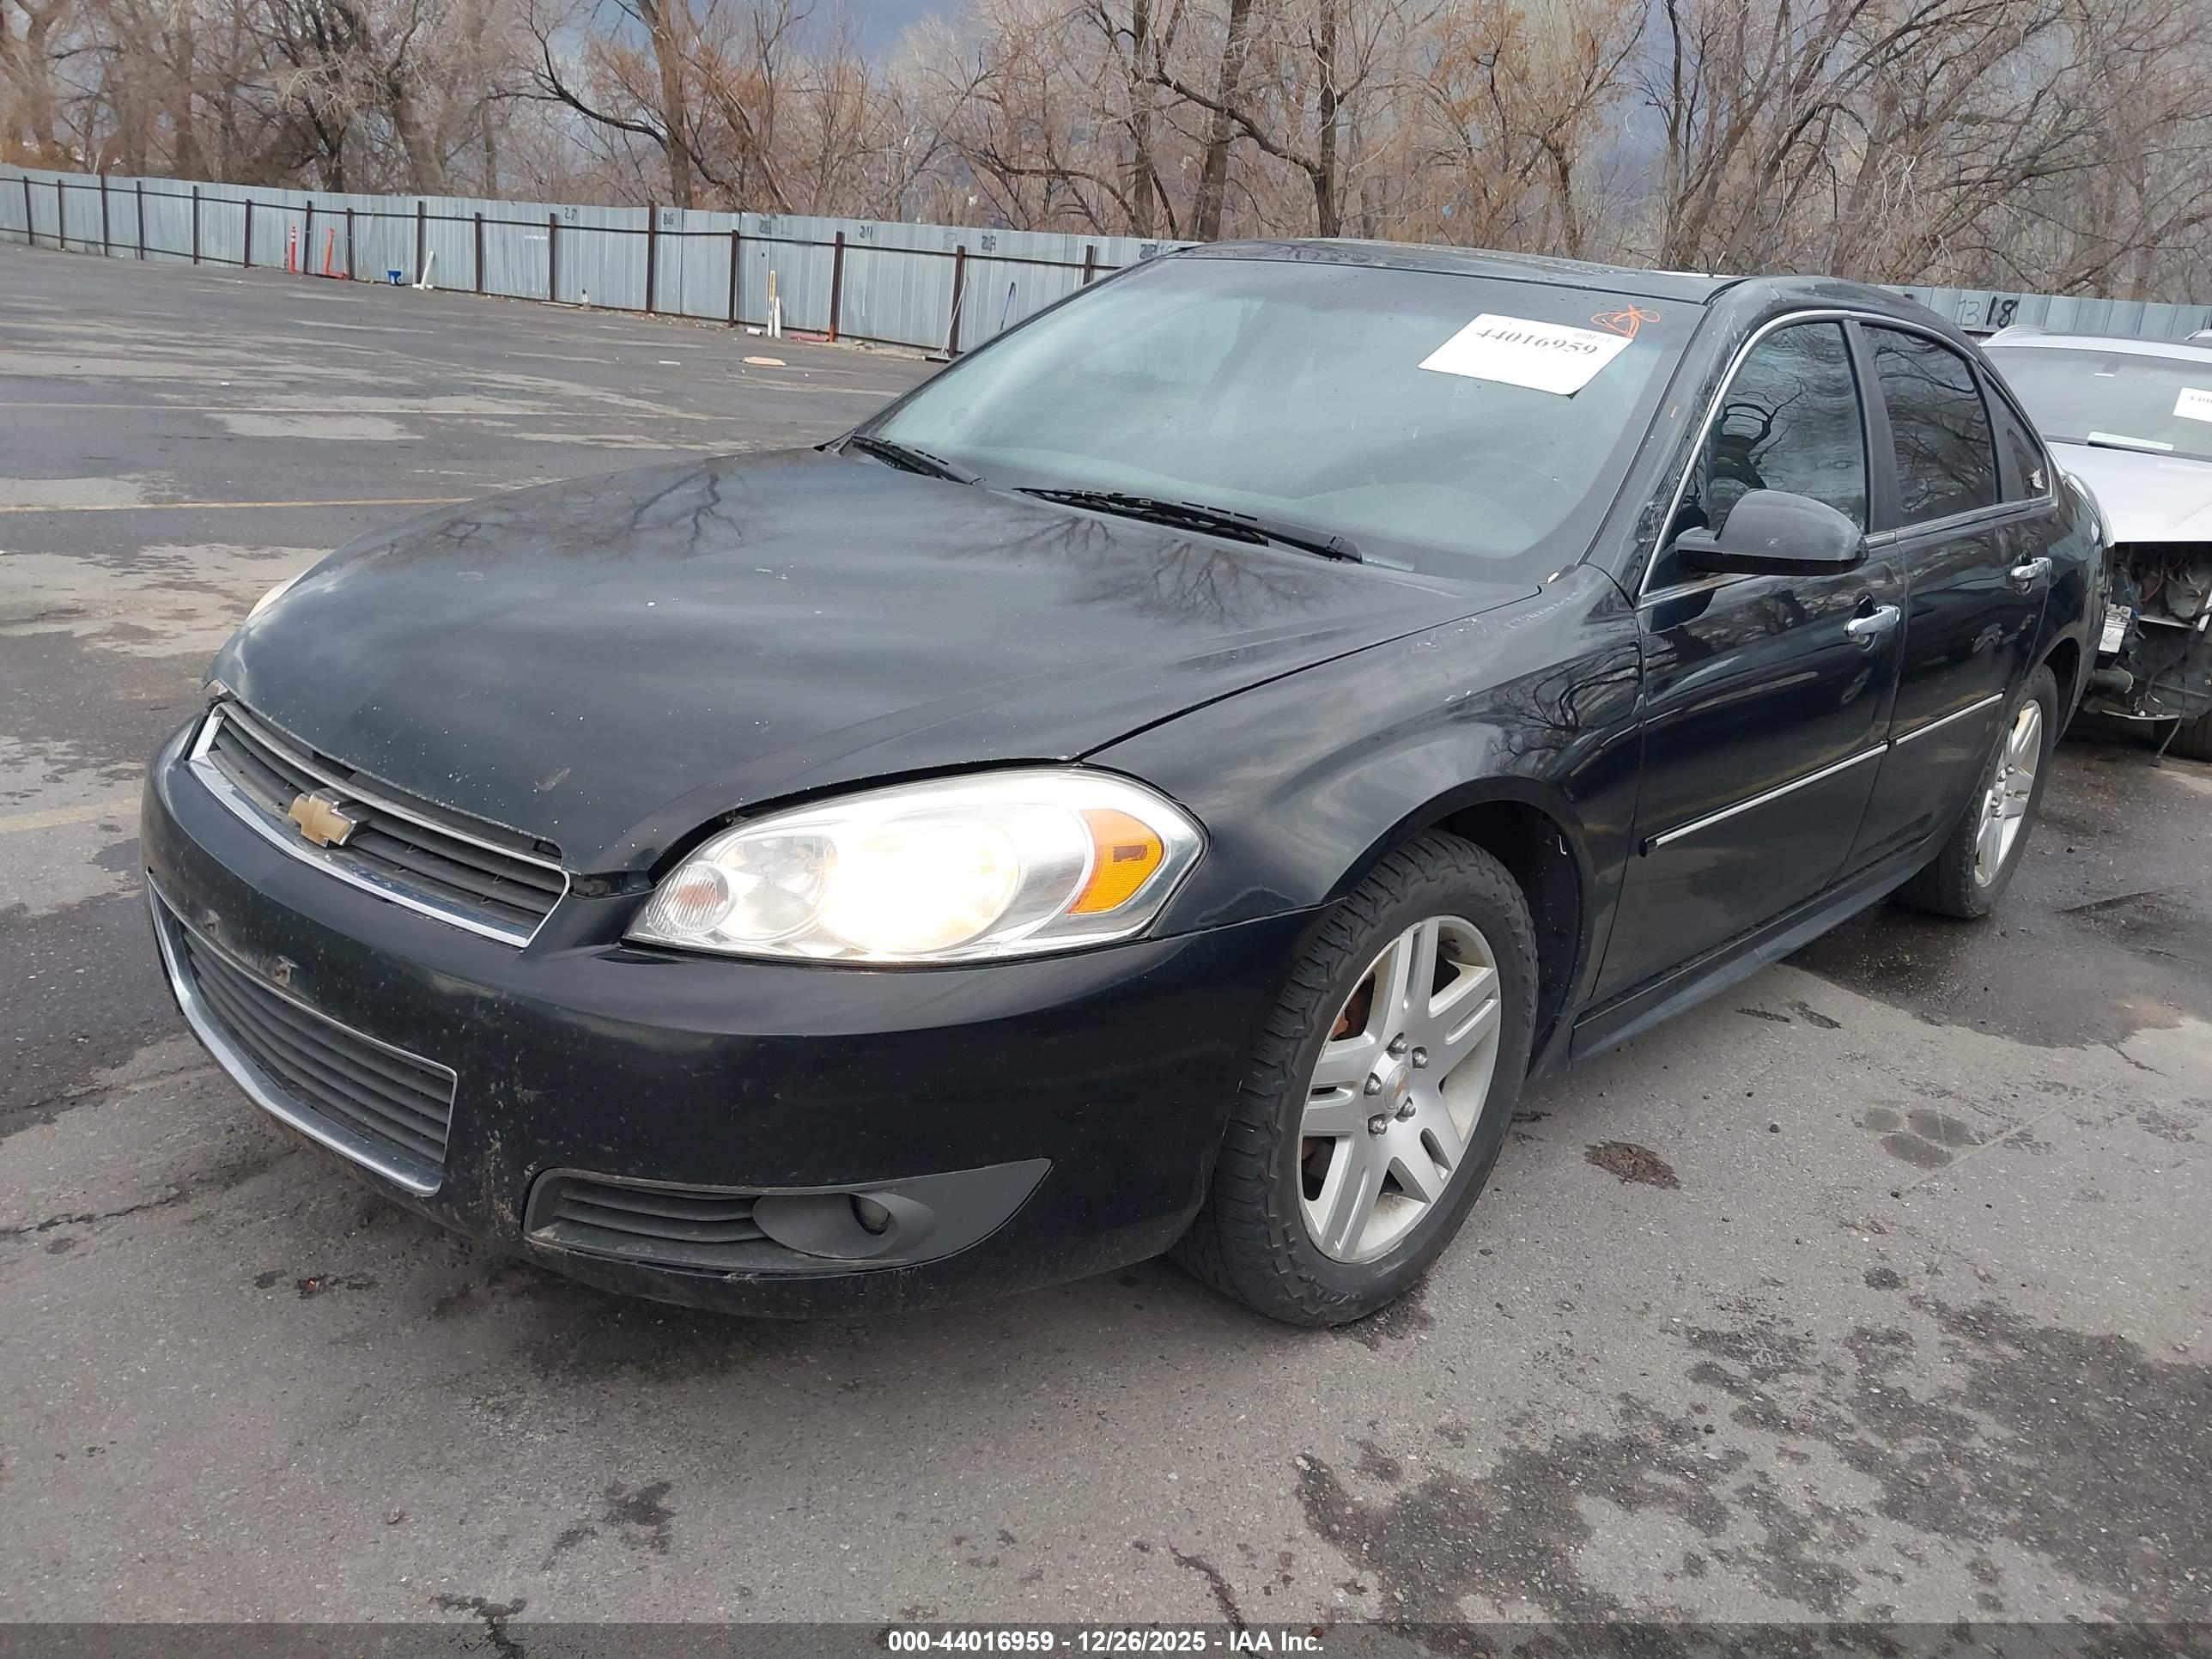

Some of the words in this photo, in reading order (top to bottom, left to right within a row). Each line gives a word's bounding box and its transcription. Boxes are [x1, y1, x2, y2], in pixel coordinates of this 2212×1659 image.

[860, 225, 873, 240] 24
[1985, 295, 2017, 329] 18
[1475, 328, 1599, 355] 44016959
